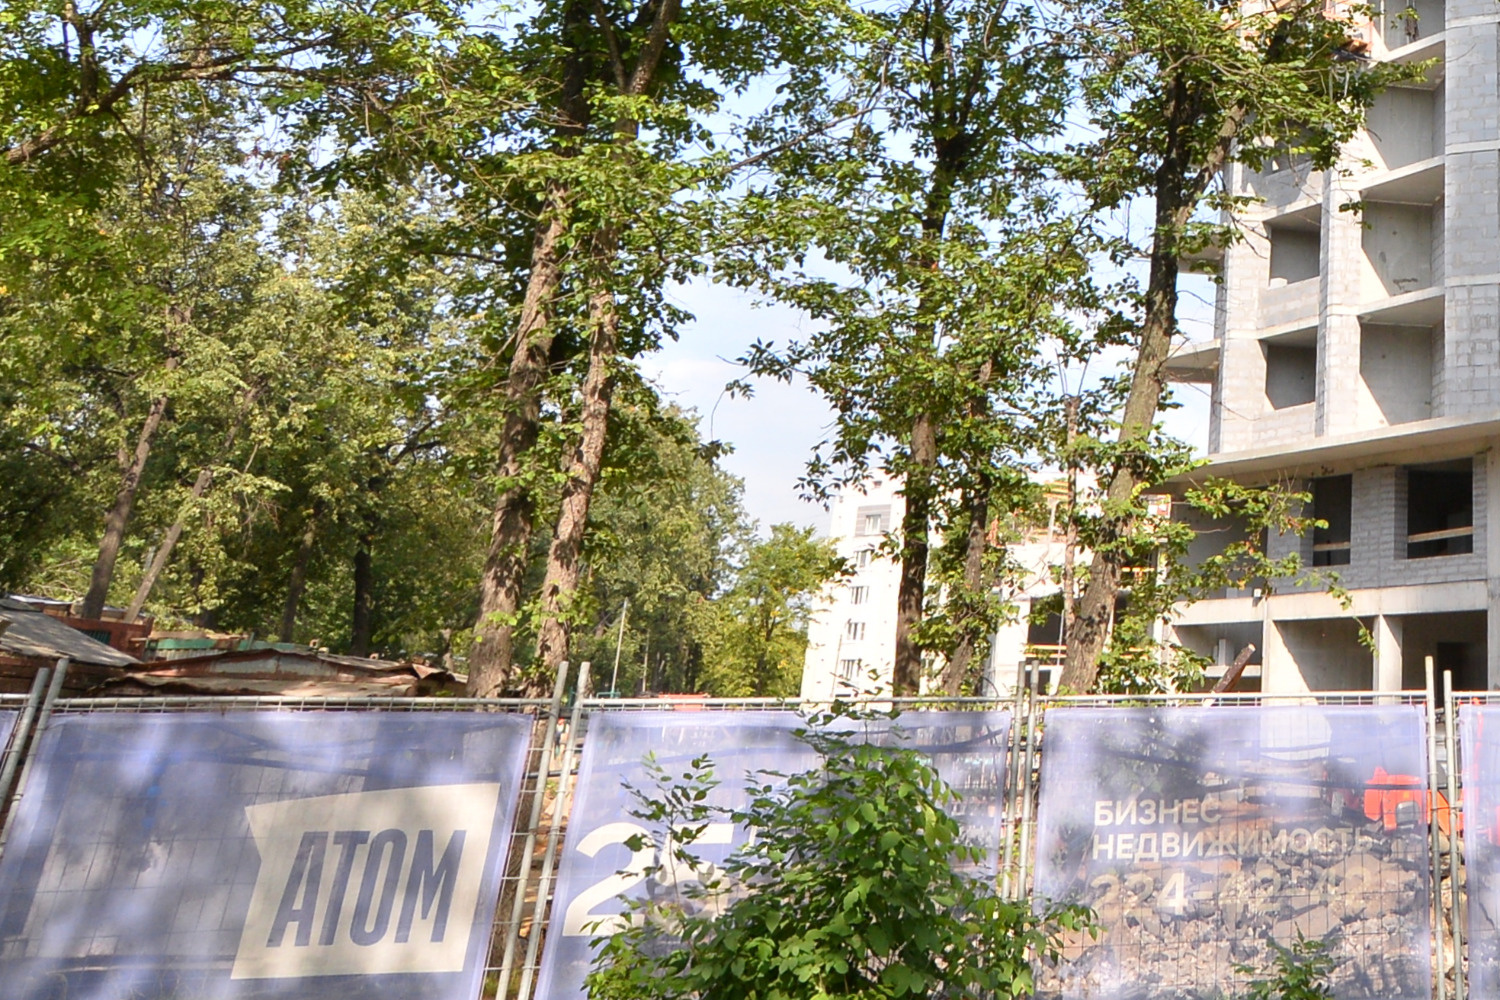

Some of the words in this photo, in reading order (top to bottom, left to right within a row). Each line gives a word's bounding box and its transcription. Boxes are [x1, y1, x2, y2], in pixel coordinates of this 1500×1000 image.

[1094, 798, 1223, 827] БИЗНЕС
[1092, 826, 1373, 863] НЕДВИЖИМОСТЬ
[265, 828, 468, 948] АТОМ
